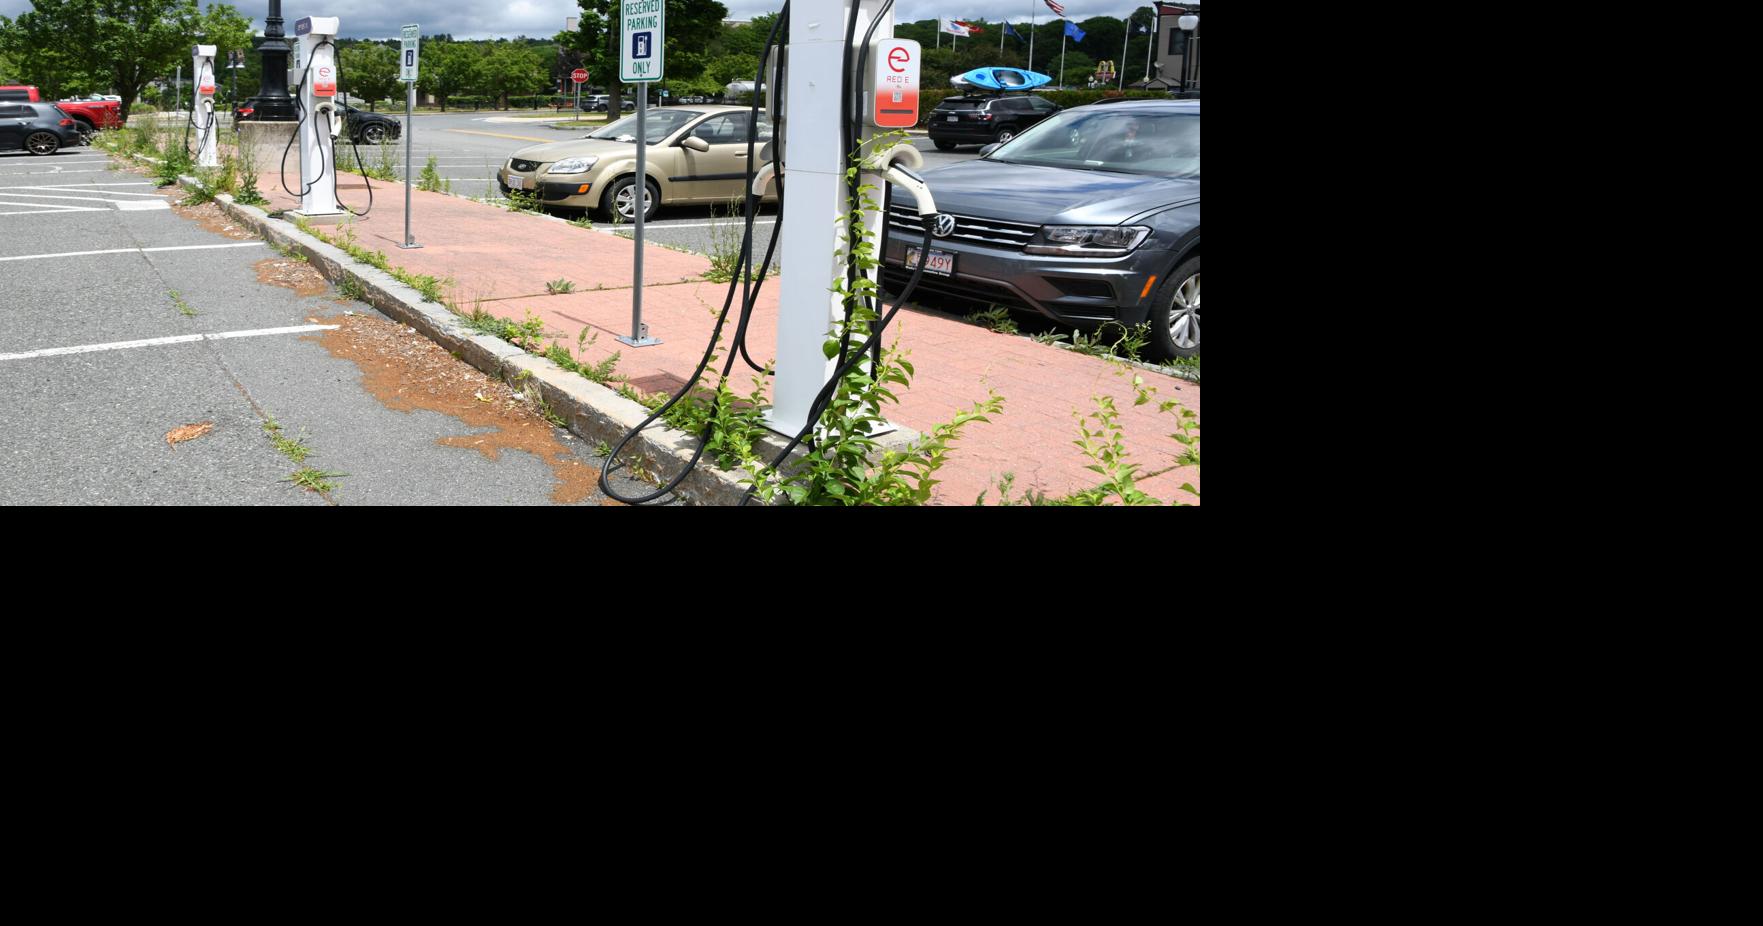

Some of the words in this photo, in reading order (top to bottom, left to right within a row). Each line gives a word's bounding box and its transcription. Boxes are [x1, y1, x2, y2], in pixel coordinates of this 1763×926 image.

[625, 0, 660, 16] RESERVED
[627, 15, 658, 31] PARKING
[632, 61, 651, 74] ONLY
[886, 75, 903, 83] RED
